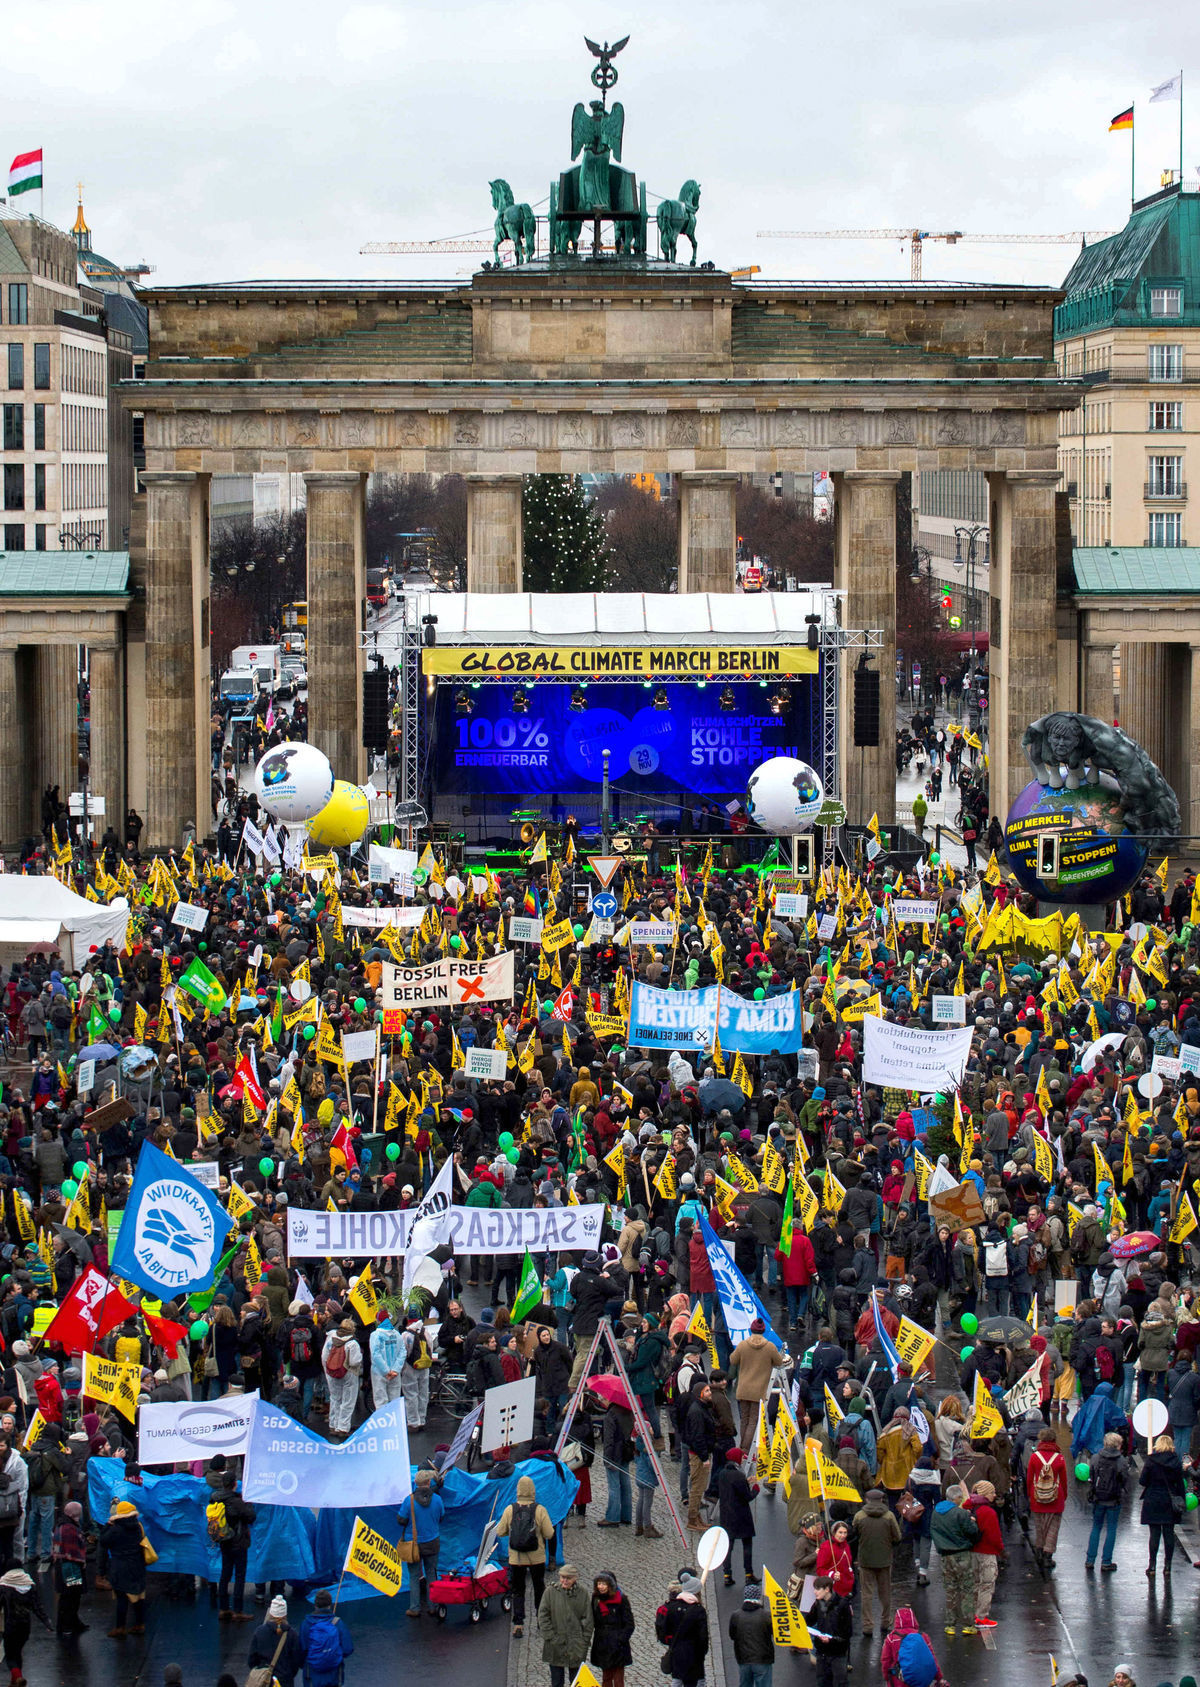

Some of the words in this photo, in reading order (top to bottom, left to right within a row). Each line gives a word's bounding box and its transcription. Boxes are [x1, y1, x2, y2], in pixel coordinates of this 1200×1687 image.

[461, 652, 565, 671] GLOBAL
[571, 651, 643, 671] CLIMATE
[650, 651, 711, 671] MARCH
[719, 651, 780, 670] BERLIN
[456, 718, 549, 748] 100%
[692, 728, 763, 746] KOHLE
[456, 754, 549, 767] ERNEUERBAR
[636, 749, 651, 761] 29
[638, 760, 652, 769] NOV
[1006, 822, 1023, 836] FRAU
[1025, 814, 1071, 829] MERKEL,
[1009, 841, 1032, 853] KLIMA
[1062, 844, 1117, 865] STOPPEN!
[1060, 863, 1111, 882] GREENPEACE
[896, 906, 935, 915] SPENDEN
[393, 965, 447, 981] FOSSIL
[449, 963, 489, 977] FREE
[393, 985, 448, 1001] BERLIN
[386, 1010, 400, 1018] AUF
[385, 1025, 400, 1033] HEN
[470, 1066, 492, 1074] JETZT!
[139, 1248, 154, 1264] JA
[148, 1261, 190, 1284] BITTE!
[773, 1591, 792, 1644] Fracking
